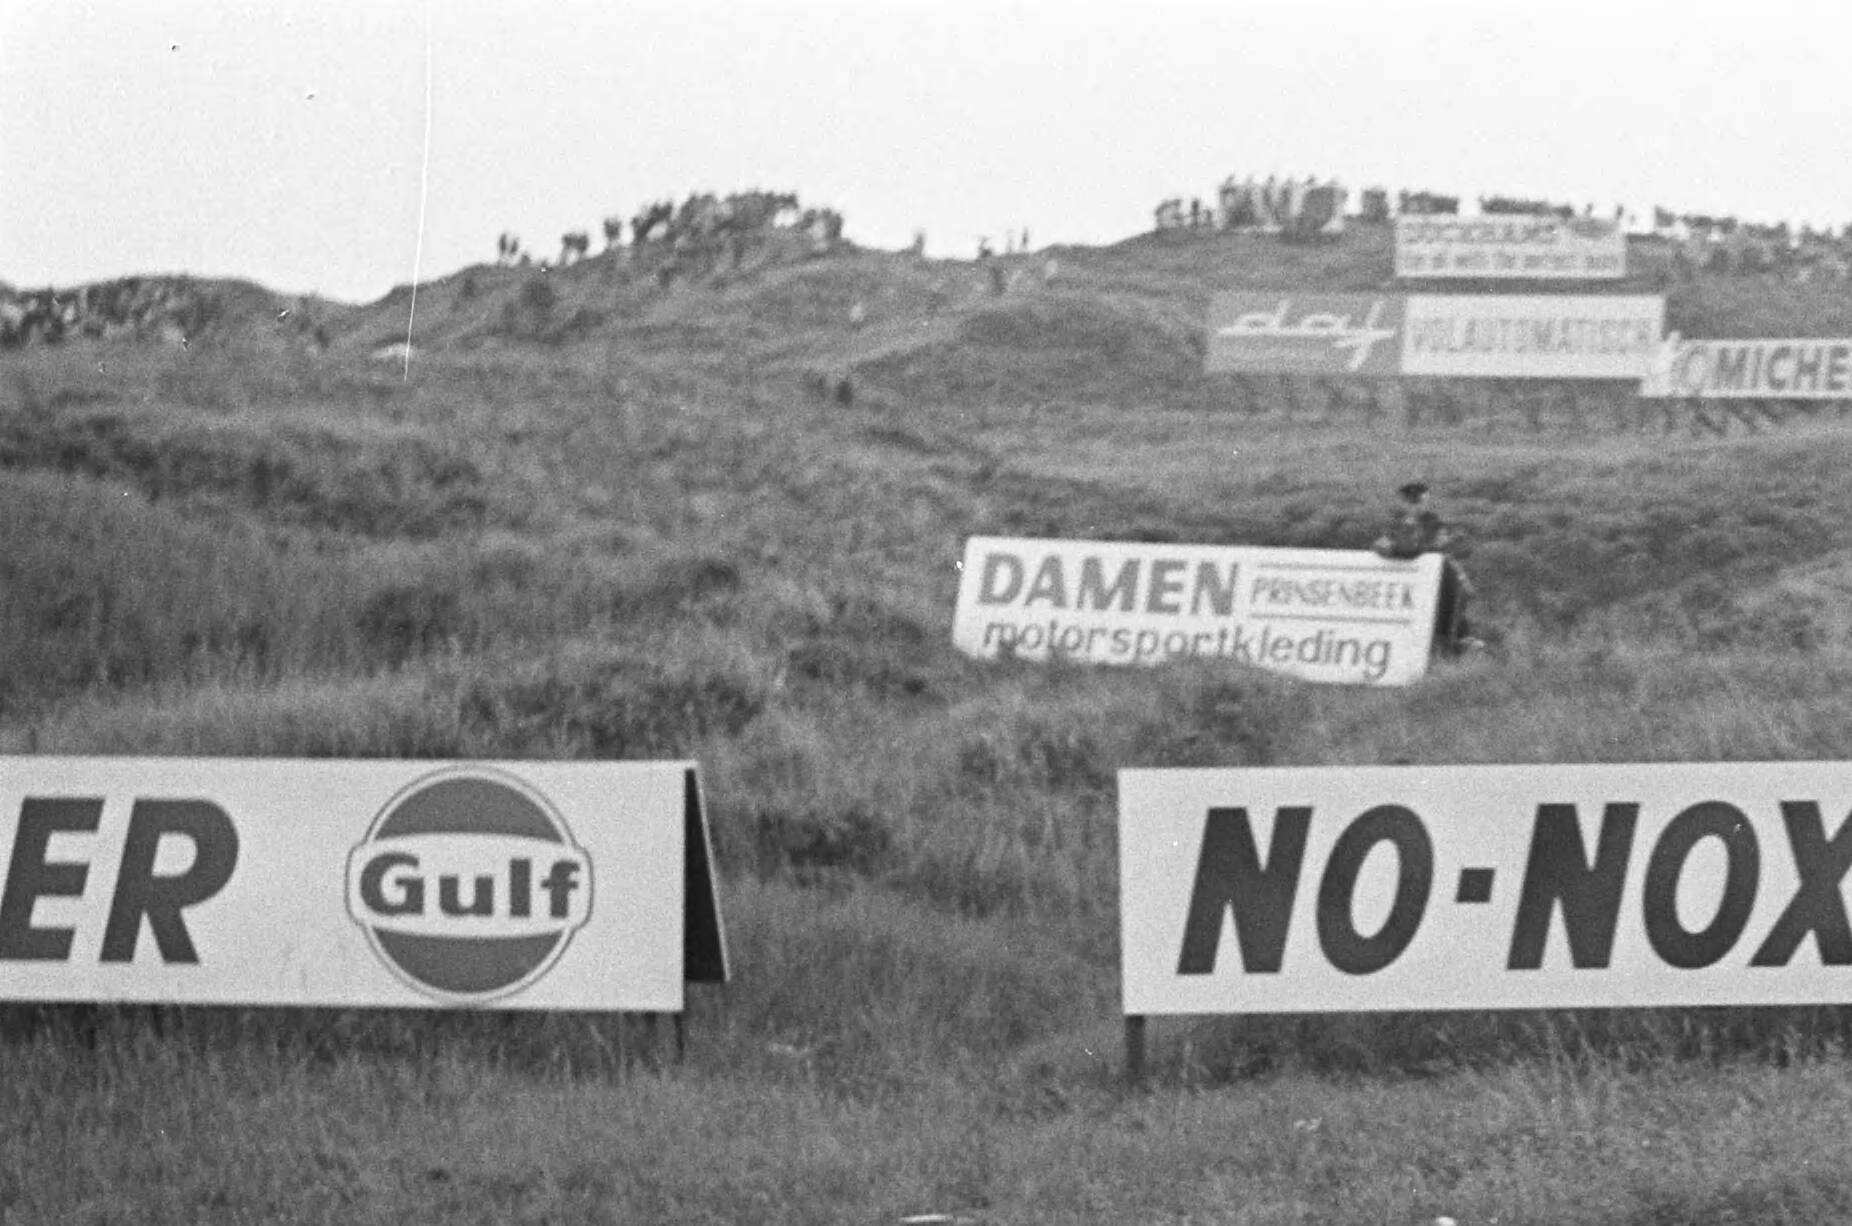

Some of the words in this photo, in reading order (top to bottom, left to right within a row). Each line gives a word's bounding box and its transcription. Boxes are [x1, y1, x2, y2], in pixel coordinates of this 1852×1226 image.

[1217, 299, 1394, 372] daf
[976, 552, 1240, 617] DAMEN
[982, 618, 1392, 679] motorsportkleding
[358, 851, 581, 918] Gulf
